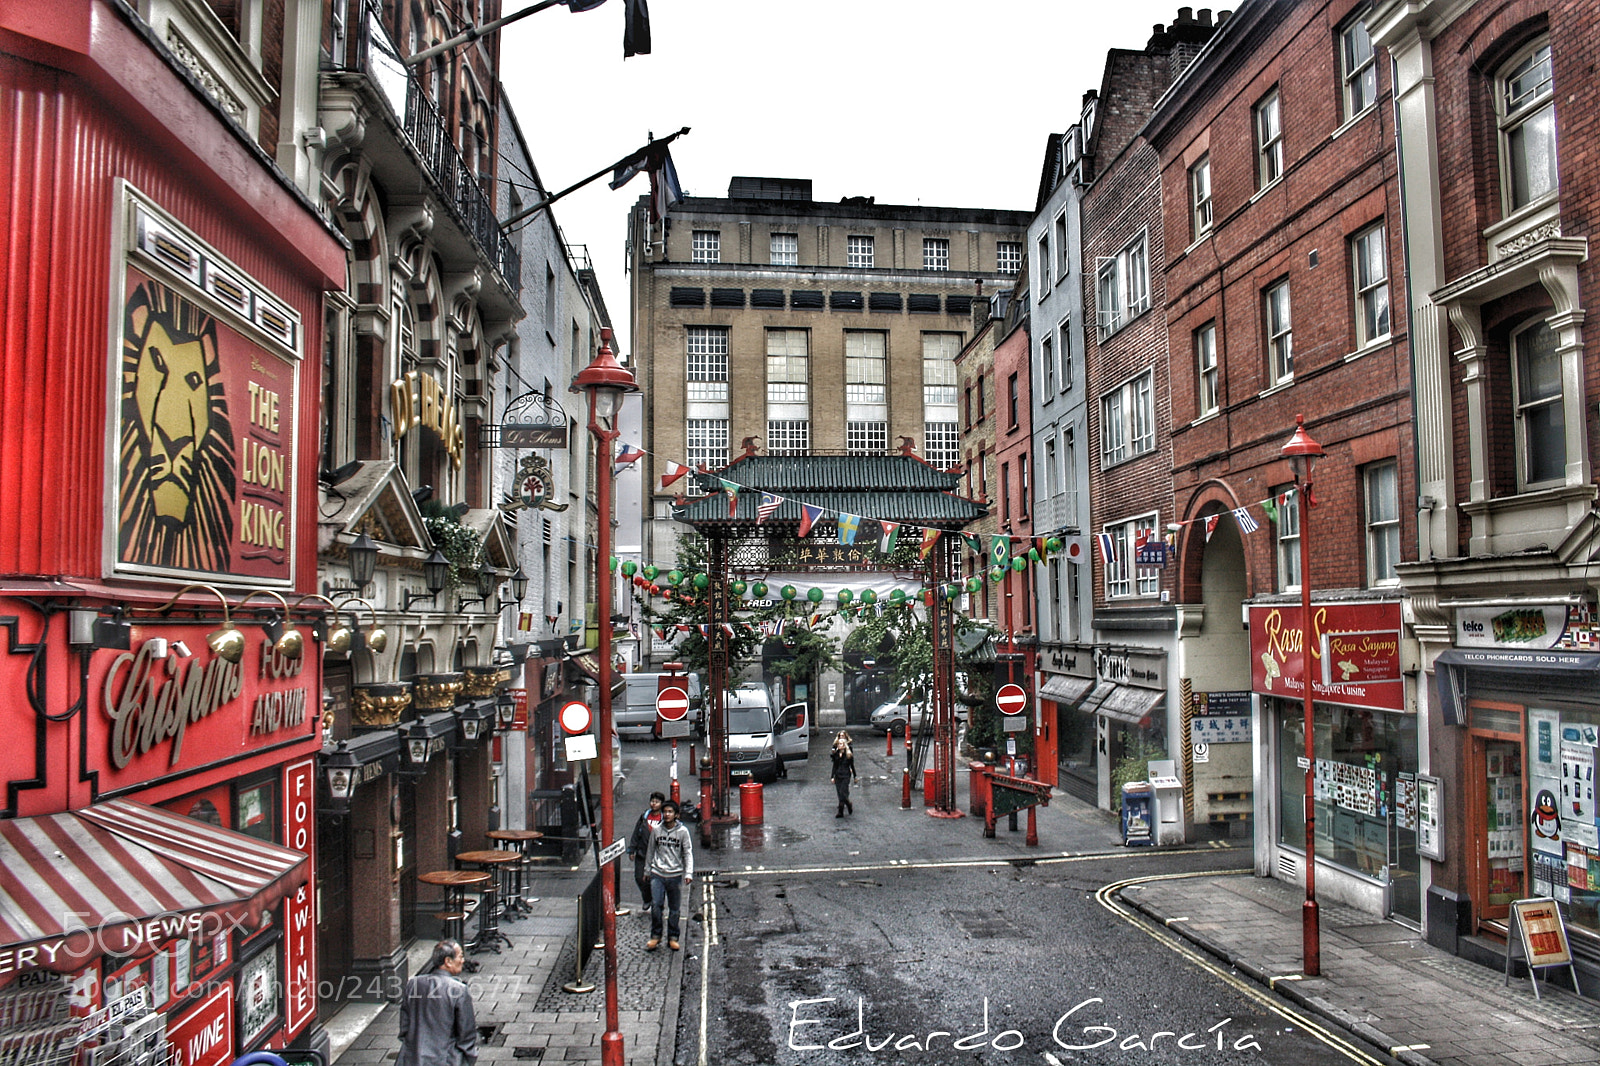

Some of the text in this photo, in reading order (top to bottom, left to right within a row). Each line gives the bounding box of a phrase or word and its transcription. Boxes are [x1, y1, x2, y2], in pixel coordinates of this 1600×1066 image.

[248, 380, 280, 434] THE
[505, 430, 562, 444] De Hems
[242, 437, 285, 492] LION
[240, 499, 285, 550] KING
[1265, 608, 1303, 663] Rasa
[1463, 620, 1484, 632] telco
[1330, 636, 1397, 658] Rasa Sayang
[1363, 658, 1389, 666] Malaysia
[1486, 654, 1533, 662] PHONECARDS
[1284, 677, 1366, 697] Malaysi Singapore Cuisine
[1363, 666, 1390, 674] Singapore
[105, 638, 244, 769] Crispins
[252, 691, 282, 736] AND
[294, 774, 310, 1012] FOO & WINE
[122, 912, 202, 948] NEWS
[189, 1012, 225, 1065] WINE
